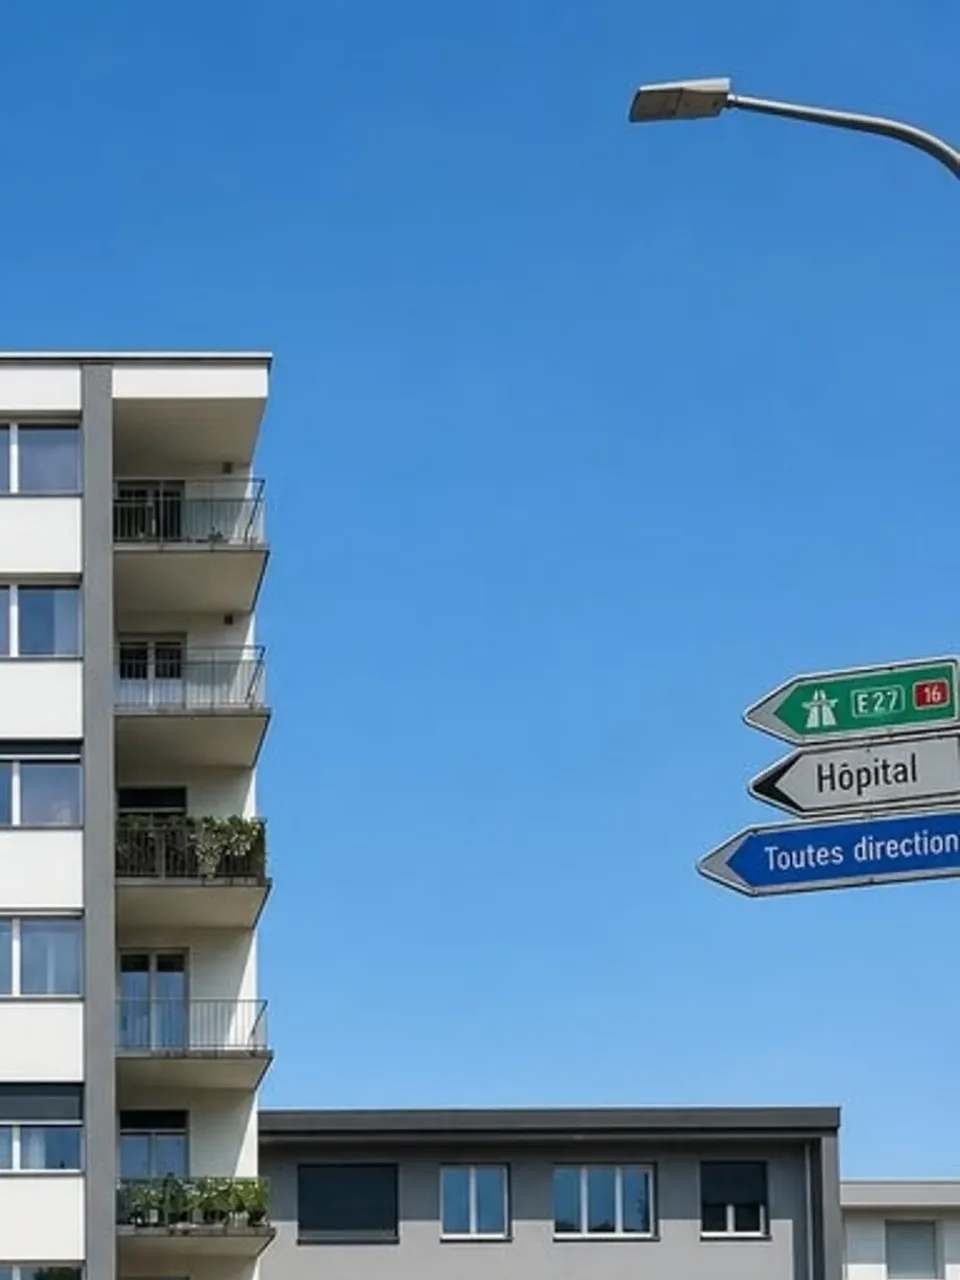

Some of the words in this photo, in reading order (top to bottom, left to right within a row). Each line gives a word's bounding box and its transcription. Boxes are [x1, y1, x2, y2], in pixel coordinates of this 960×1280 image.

[925, 685, 942, 704] 16
[816, 752, 918, 796] Hôpital
[763, 844, 844, 872] Toutes
[853, 829, 960, 863] direction
